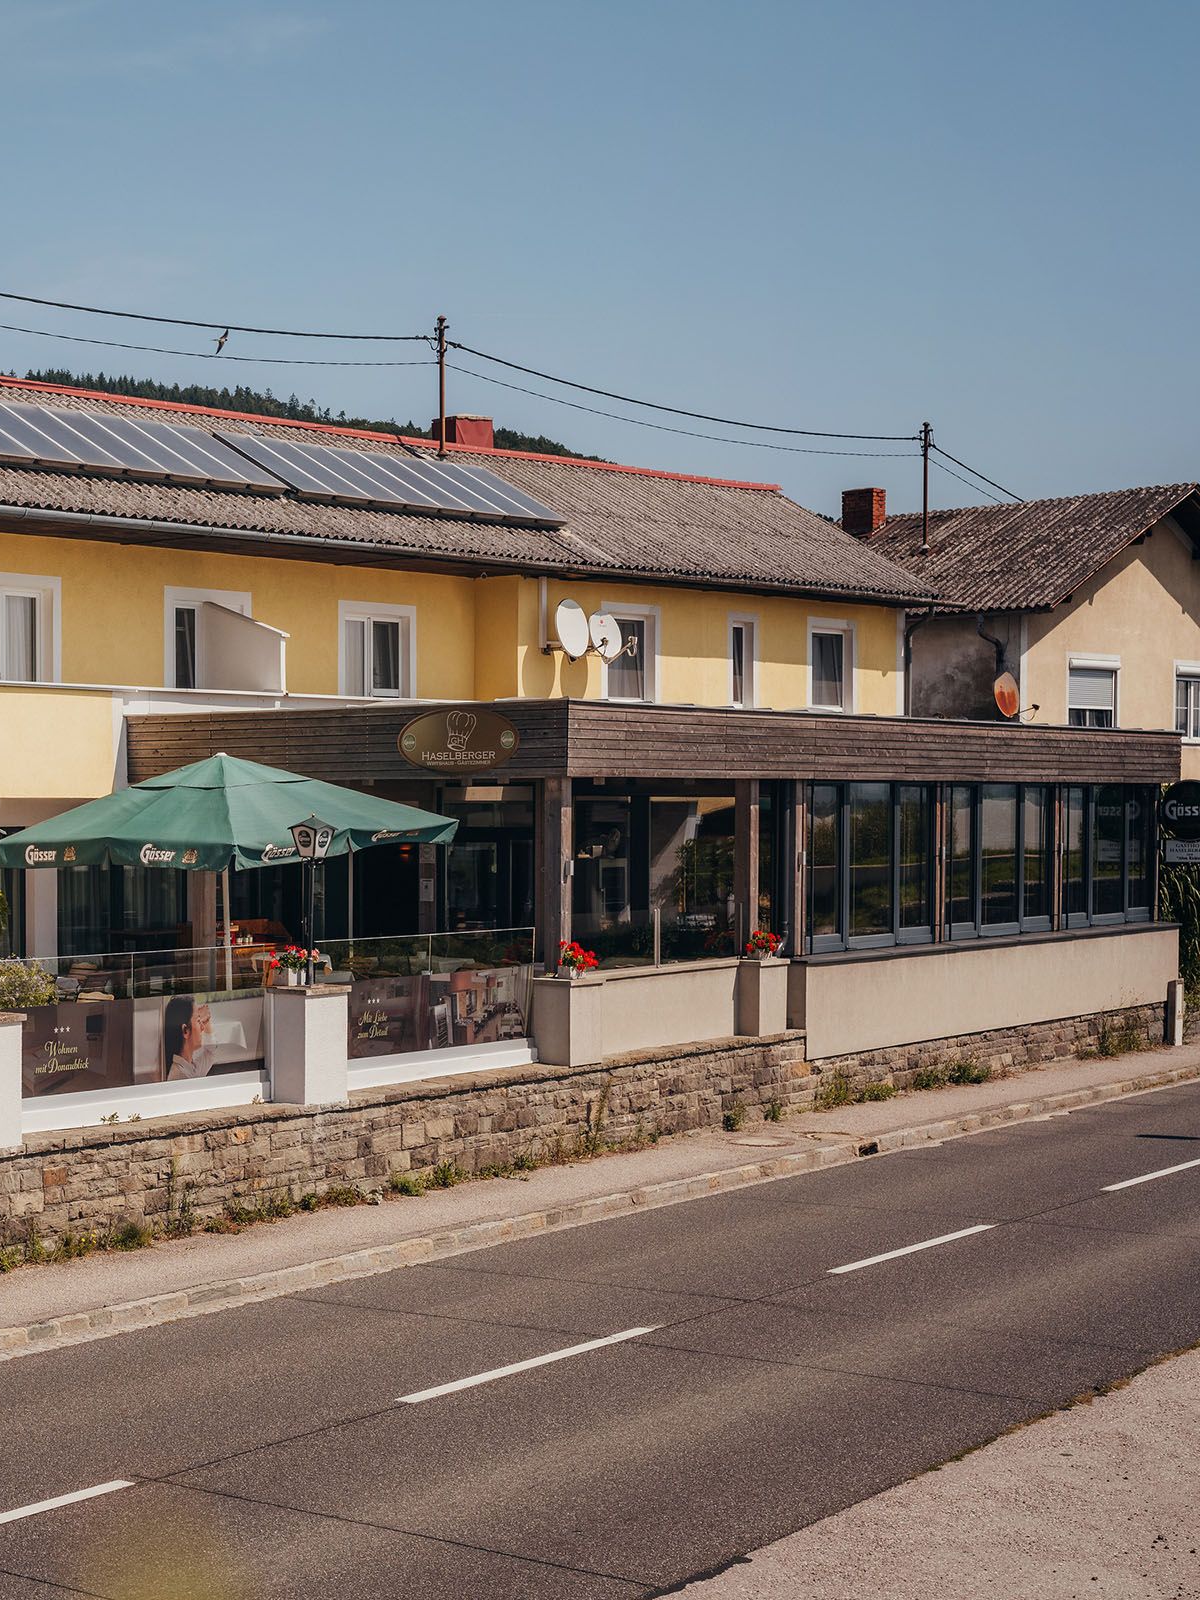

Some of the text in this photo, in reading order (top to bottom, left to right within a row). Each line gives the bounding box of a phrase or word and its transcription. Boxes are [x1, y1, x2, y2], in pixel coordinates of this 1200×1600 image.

[421, 751, 496, 761] HASELBERGER
[1165, 800, 1200, 820] Göss
[25, 844, 57, 865] Gösser
[140, 843, 176, 865] Gösser
[261, 843, 297, 862] Gösser
[369, 1025, 389, 1039] Detail
[44, 1040, 78, 1057] Wohnen
[34, 1057, 90, 1074] mit Donaublick
